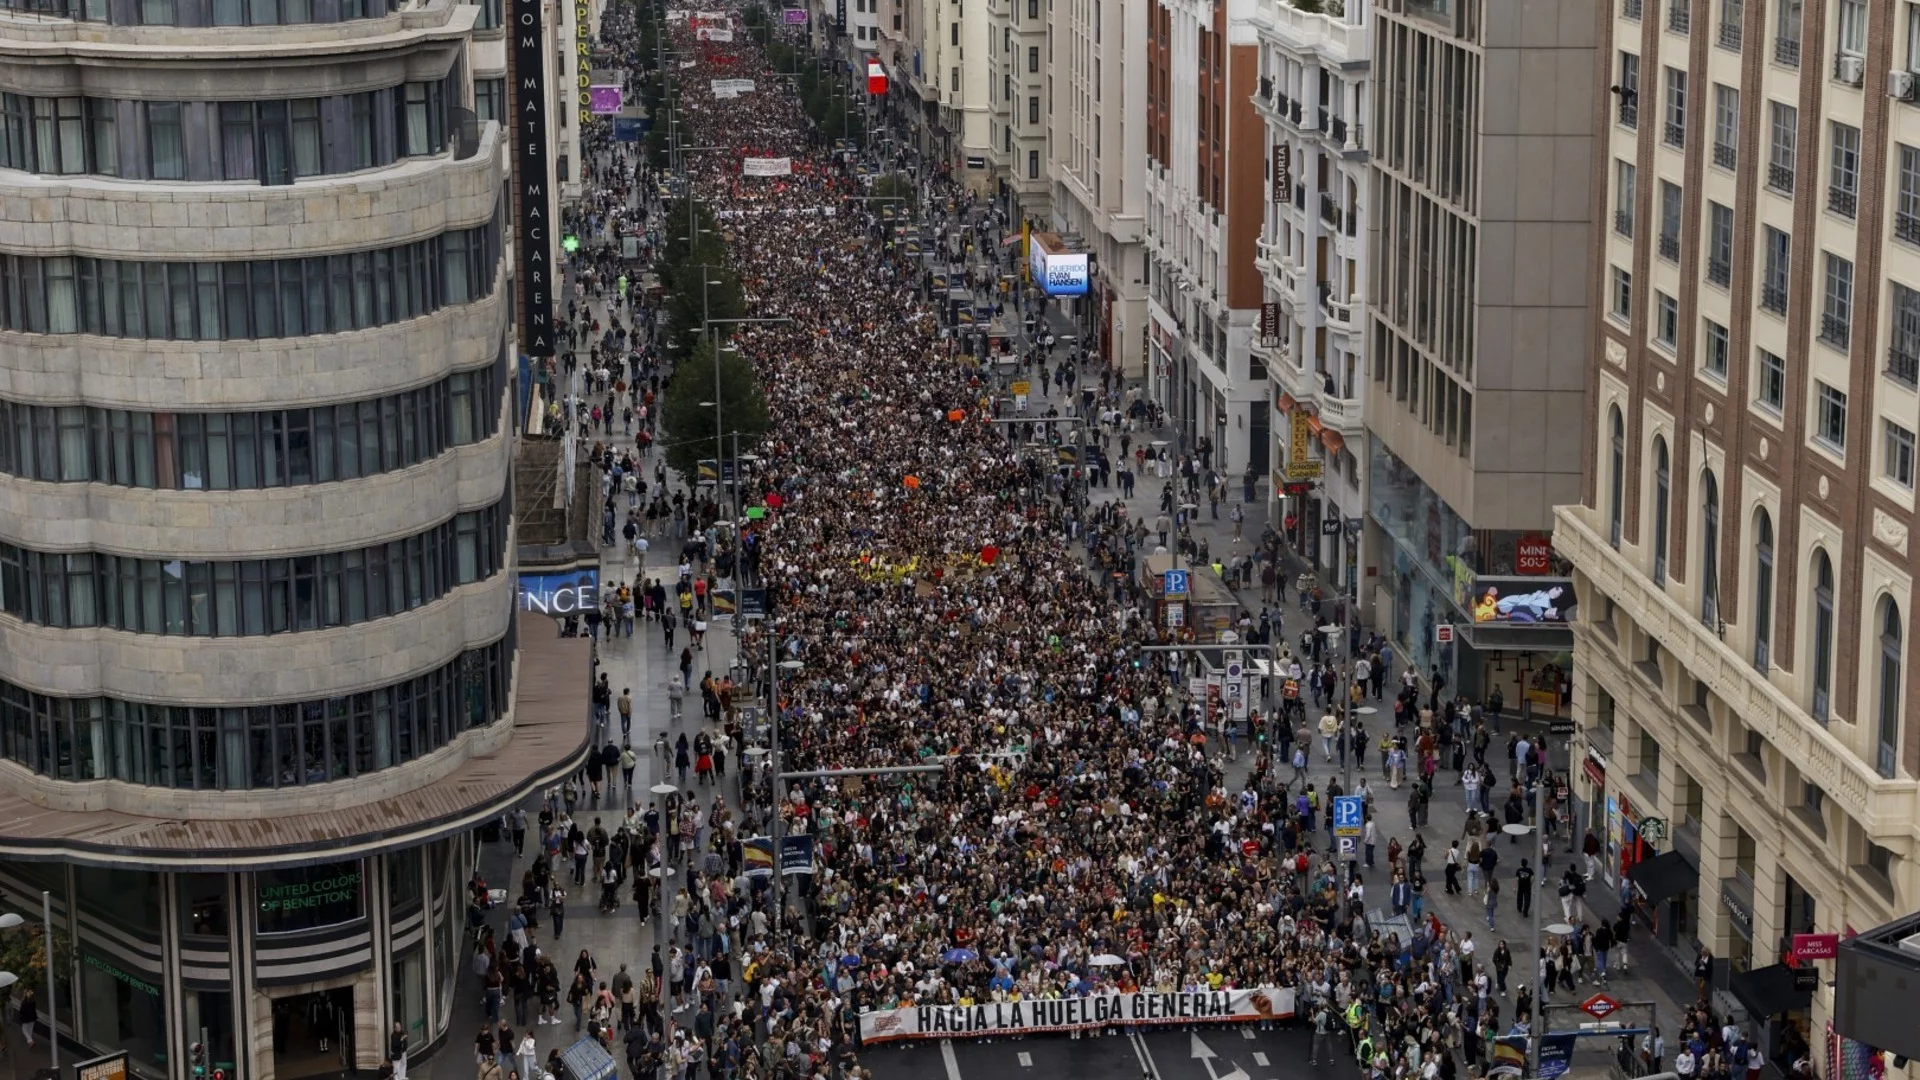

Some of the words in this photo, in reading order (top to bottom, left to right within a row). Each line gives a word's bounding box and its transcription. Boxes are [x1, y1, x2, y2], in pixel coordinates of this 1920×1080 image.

[521, 0, 536, 48] OM
[524, 78, 537, 155] MATE
[1277, 147, 1286, 189] LAURIA
[527, 184, 546, 347] MACARENA
[1049, 264, 1086, 272] QUERIDO
[1049, 272, 1071, 280] EVAN
[1049, 279, 1082, 287] HANSEN
[1170, 573, 1183, 592] P
[518, 586, 595, 615] NCE
[1340, 801, 1357, 824] P
[1340, 838, 1353, 854] P
[260, 883, 309, 898] UNITED
[312, 872, 362, 892] COLORS
[260, 900, 280, 912] OF
[917, 1004, 988, 1032] HACIA
[996, 1002, 1024, 1028] LA
[1032, 995, 1123, 1026] HUELGA
[1132, 991, 1236, 1018] GENERAL
